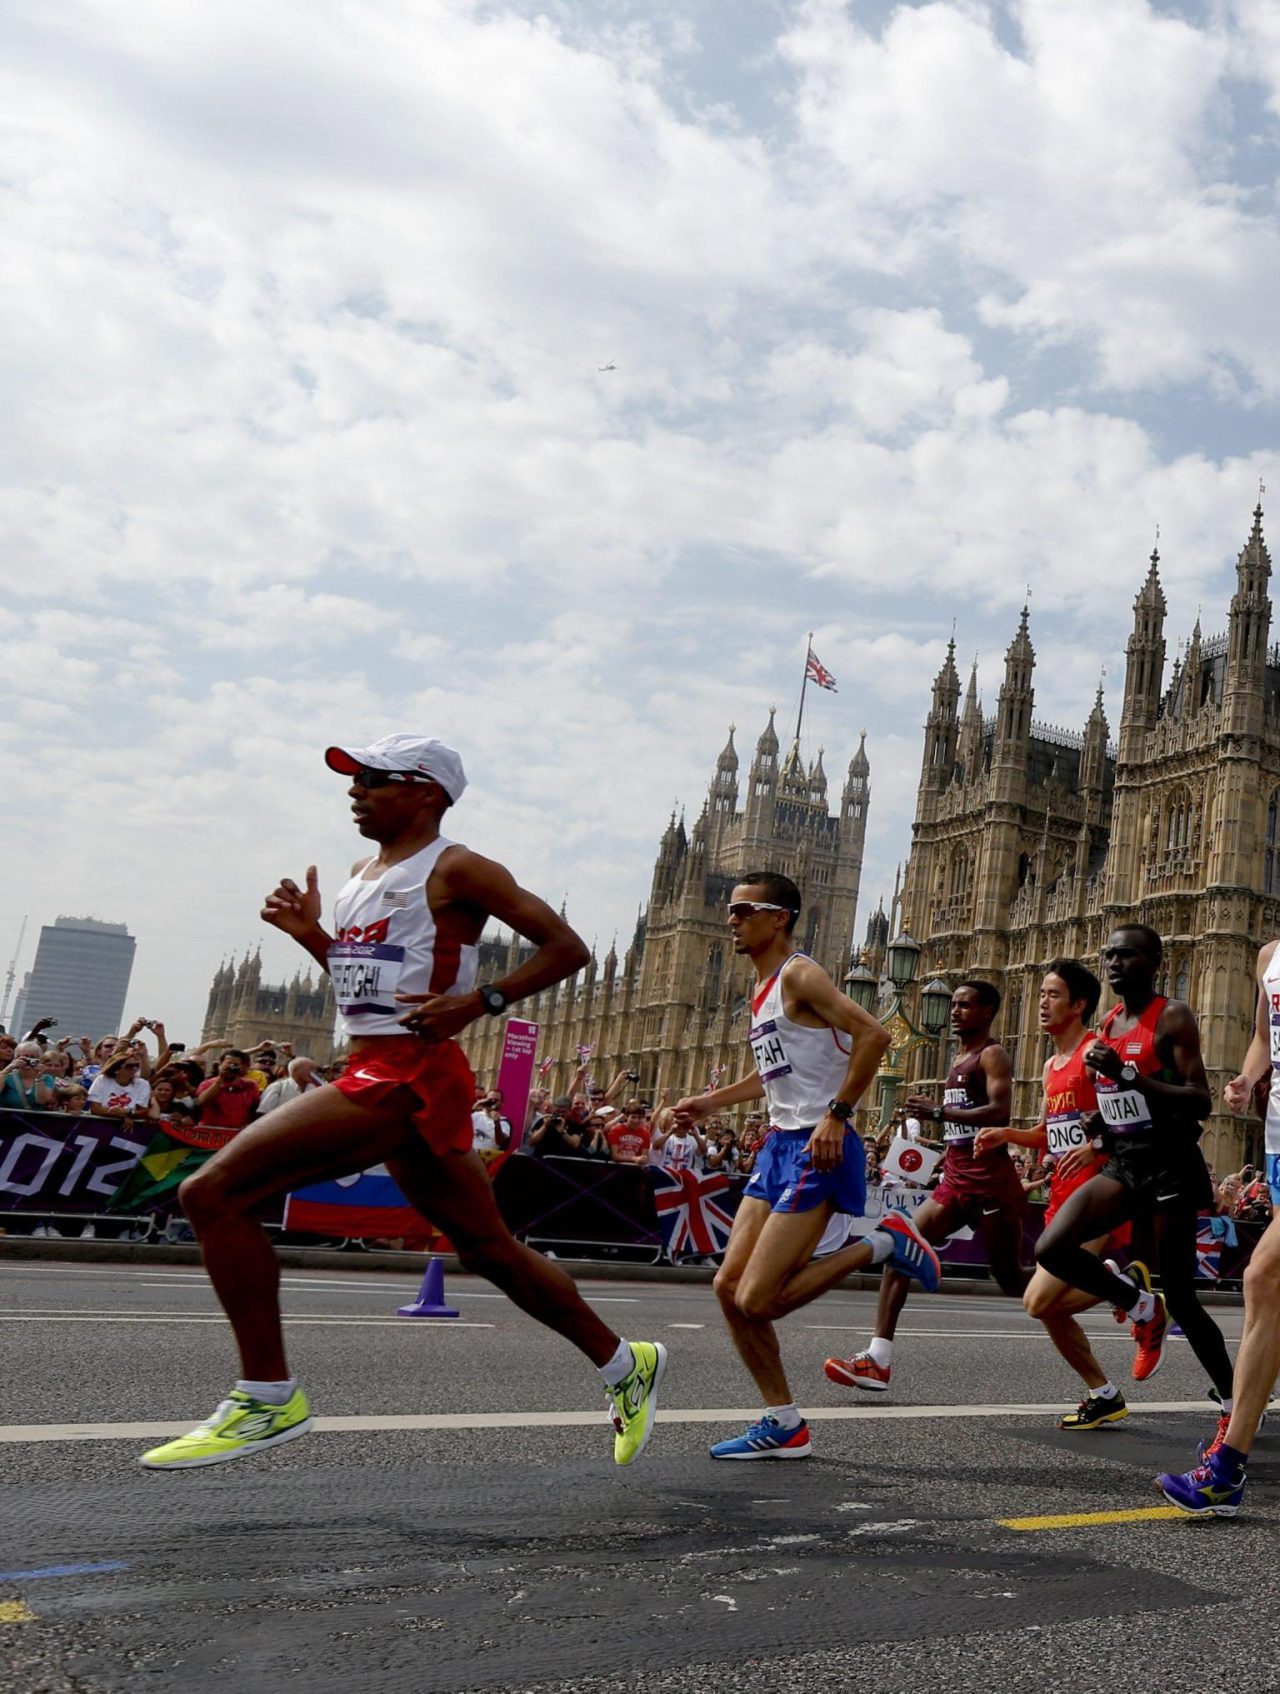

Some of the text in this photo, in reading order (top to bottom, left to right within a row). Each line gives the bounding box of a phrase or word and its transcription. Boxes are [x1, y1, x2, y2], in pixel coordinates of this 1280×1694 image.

[1101, 1096, 1140, 1120] MUTAI
[1048, 1125, 1084, 1149] ONG
[0, 1133, 149, 1196] 012
